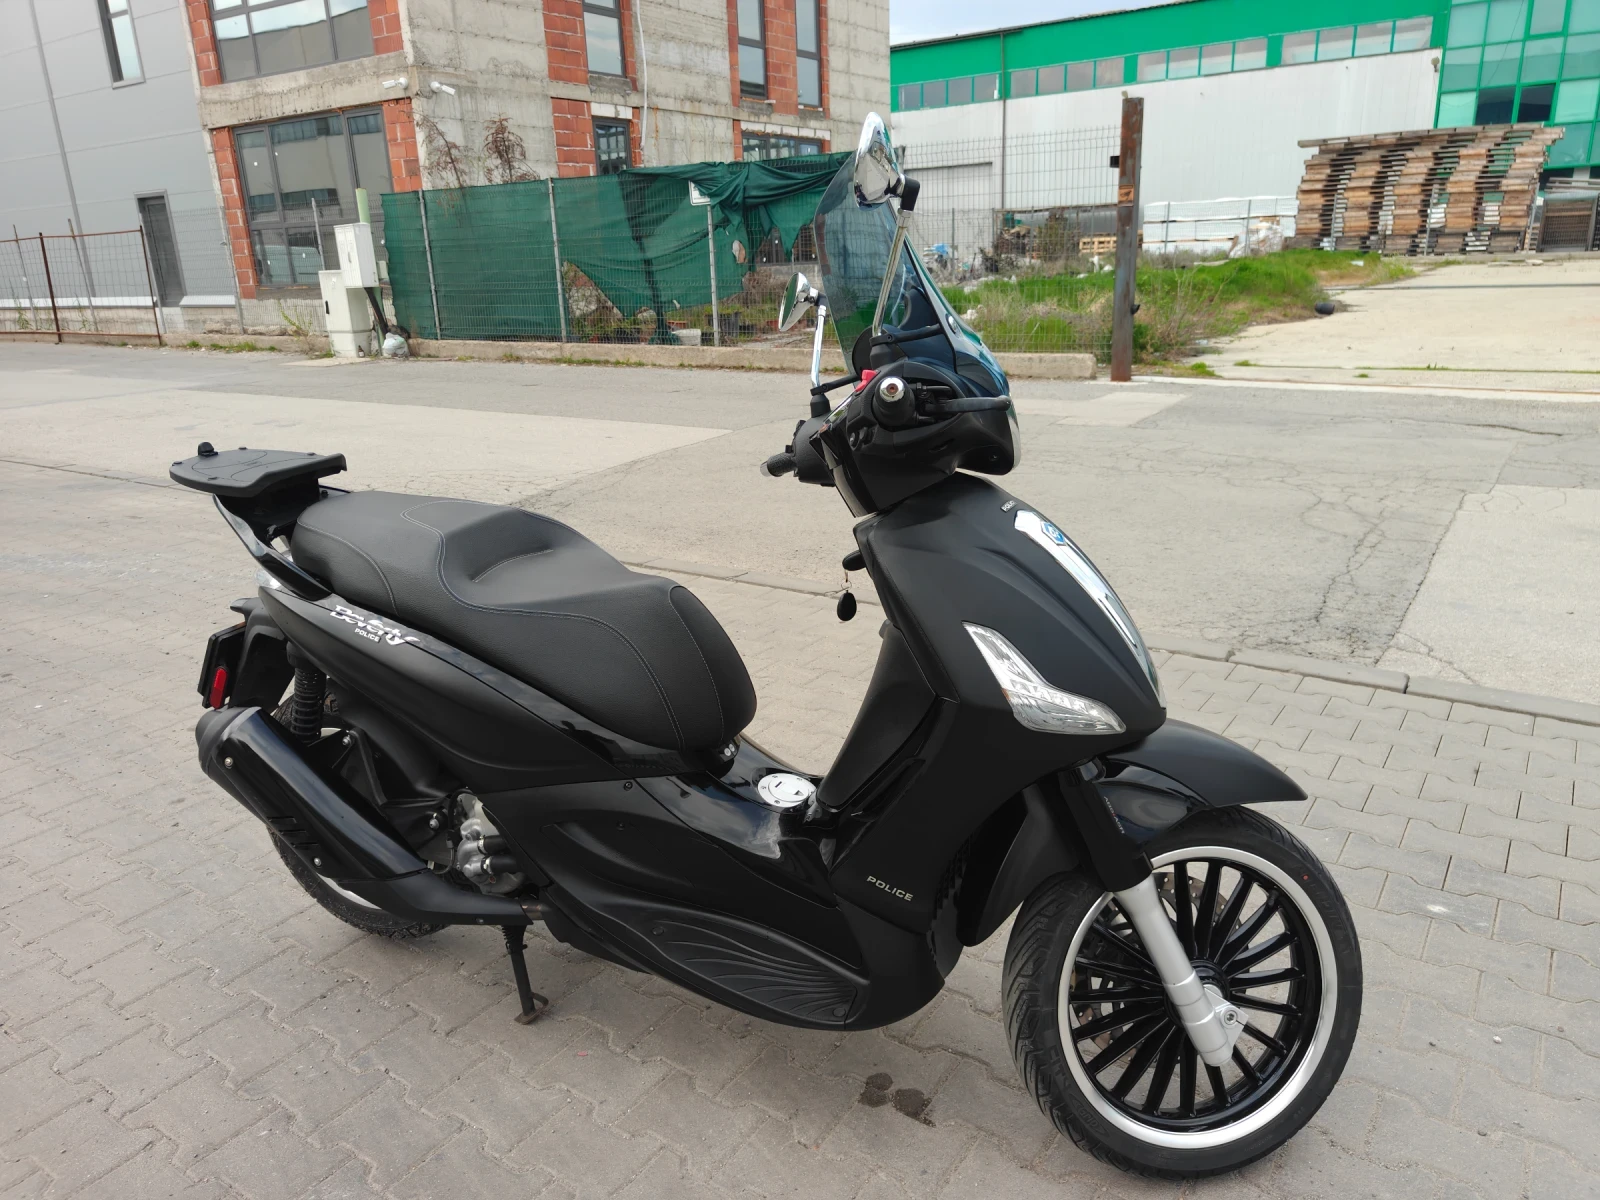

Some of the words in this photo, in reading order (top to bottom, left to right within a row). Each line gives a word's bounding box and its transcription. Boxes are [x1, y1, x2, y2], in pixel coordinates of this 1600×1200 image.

[330, 605, 420, 645] Beverly
[354, 628, 381, 643] POLICE
[866, 875, 914, 902] POLICE
